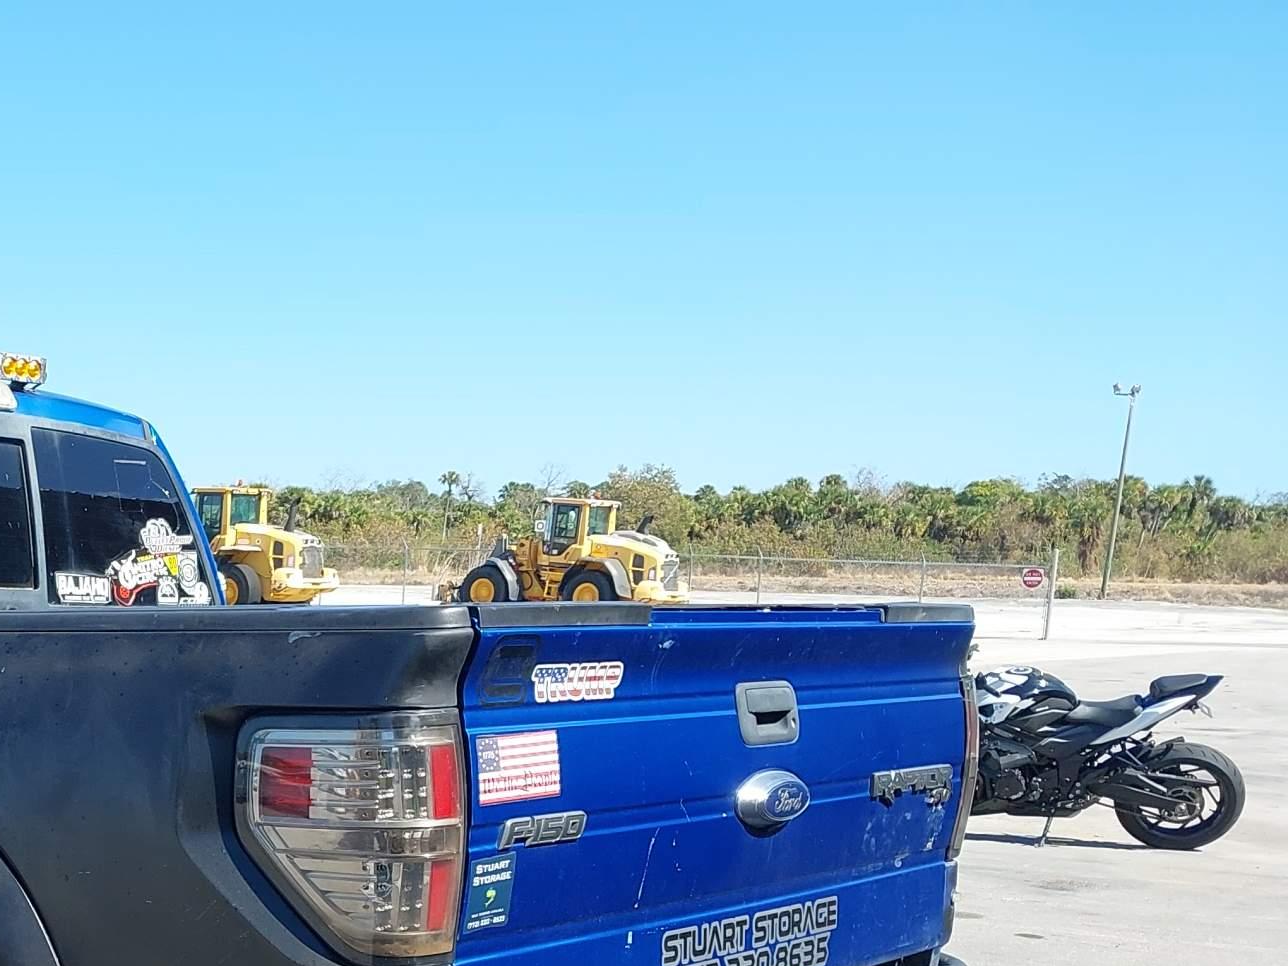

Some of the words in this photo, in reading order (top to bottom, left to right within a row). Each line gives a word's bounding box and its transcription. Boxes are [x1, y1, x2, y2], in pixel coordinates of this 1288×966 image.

[532, 662, 623, 702] TRUMP
[774, 787, 804, 812] Ford
[872, 765, 953, 801] RAPTOR
[497, 810, 587, 850] F-150
[472, 871, 512, 887] STORAGE
[476, 860, 511, 875] STUART
[752, 896, 838, 948] STORAGE
